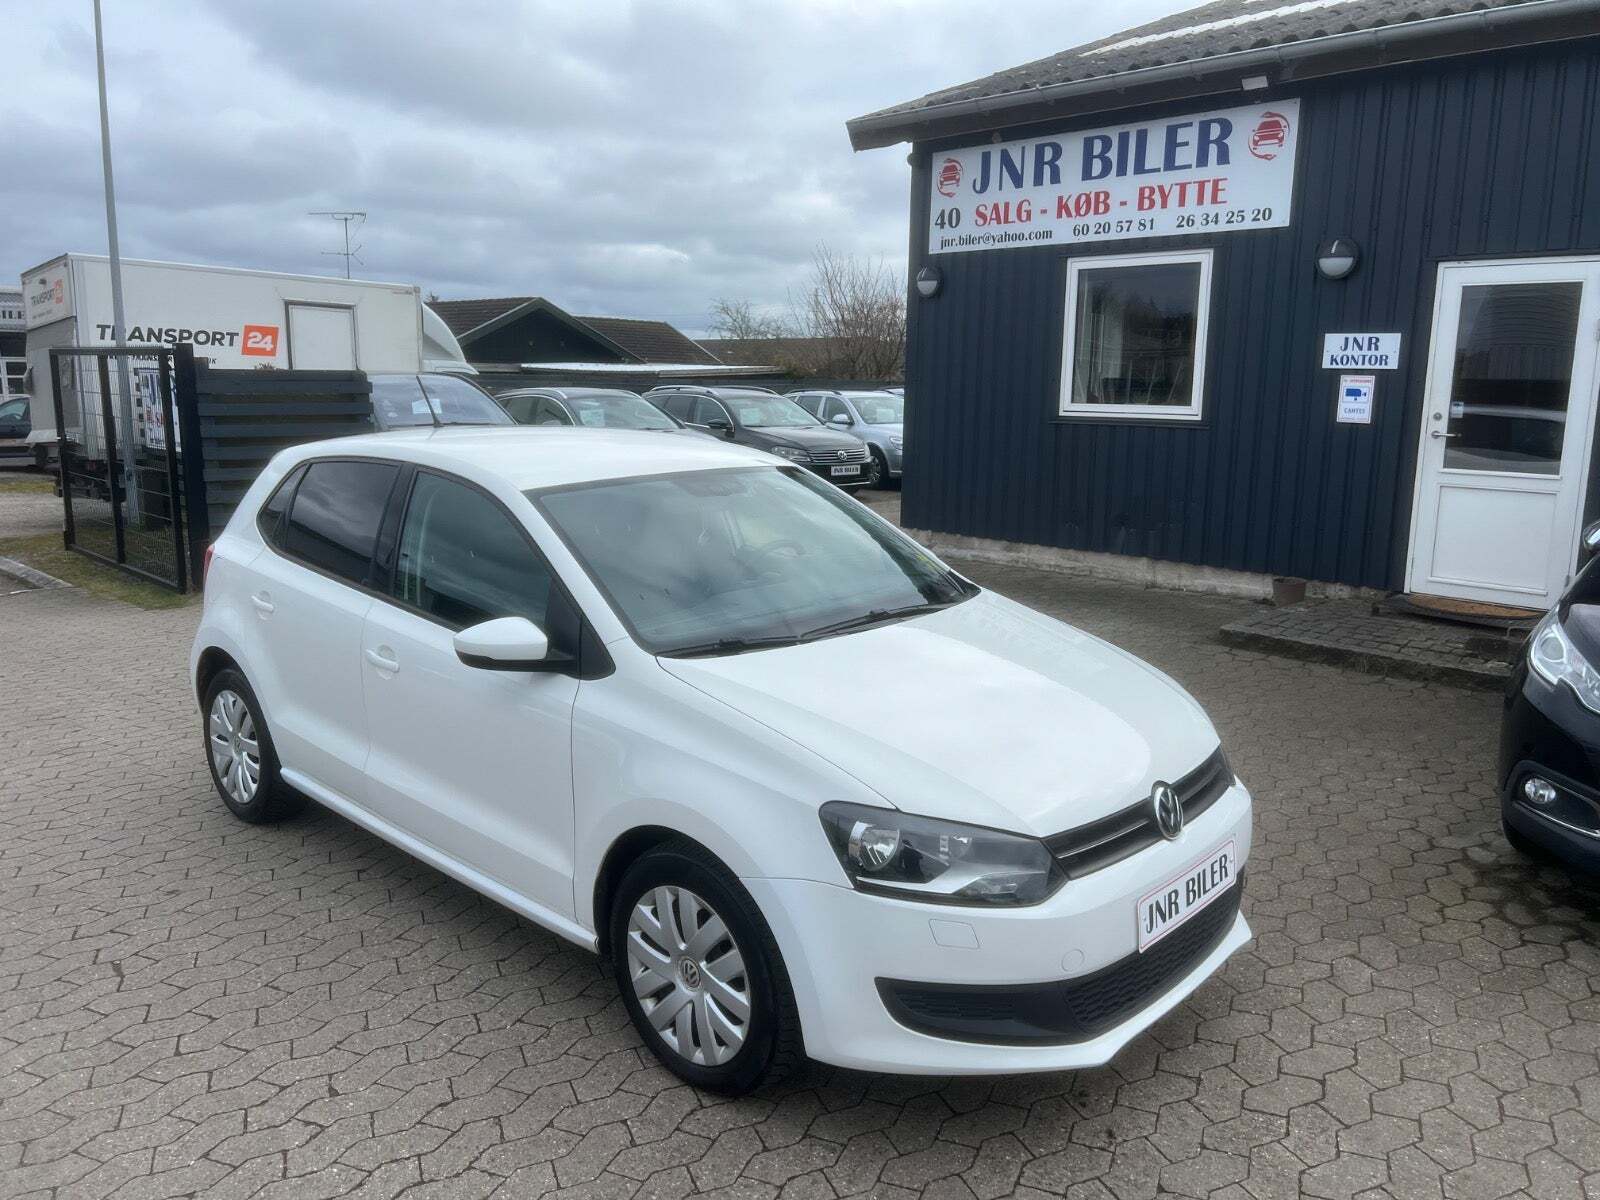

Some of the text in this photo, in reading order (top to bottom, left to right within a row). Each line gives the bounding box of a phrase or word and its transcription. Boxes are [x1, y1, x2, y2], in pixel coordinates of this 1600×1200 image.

[972, 117, 1233, 195] JNR BILER
[974, 199, 1032, 227] SALG
[1056, 189, 1111, 219] KØB
[1137, 177, 1228, 212] BYTTE
[934, 207, 961, 230] 40
[1073, 207, 1272, 237] 60 20 57 81 26 34 25 20
[940, 229, 1053, 250] jnr.biler@yahoo.com
[246, 331, 274, 352] 24
[1340, 336, 1380, 352] JNR
[1329, 354, 1389, 367] KONTOR
[1145, 853, 1229, 934] JNR BILER
